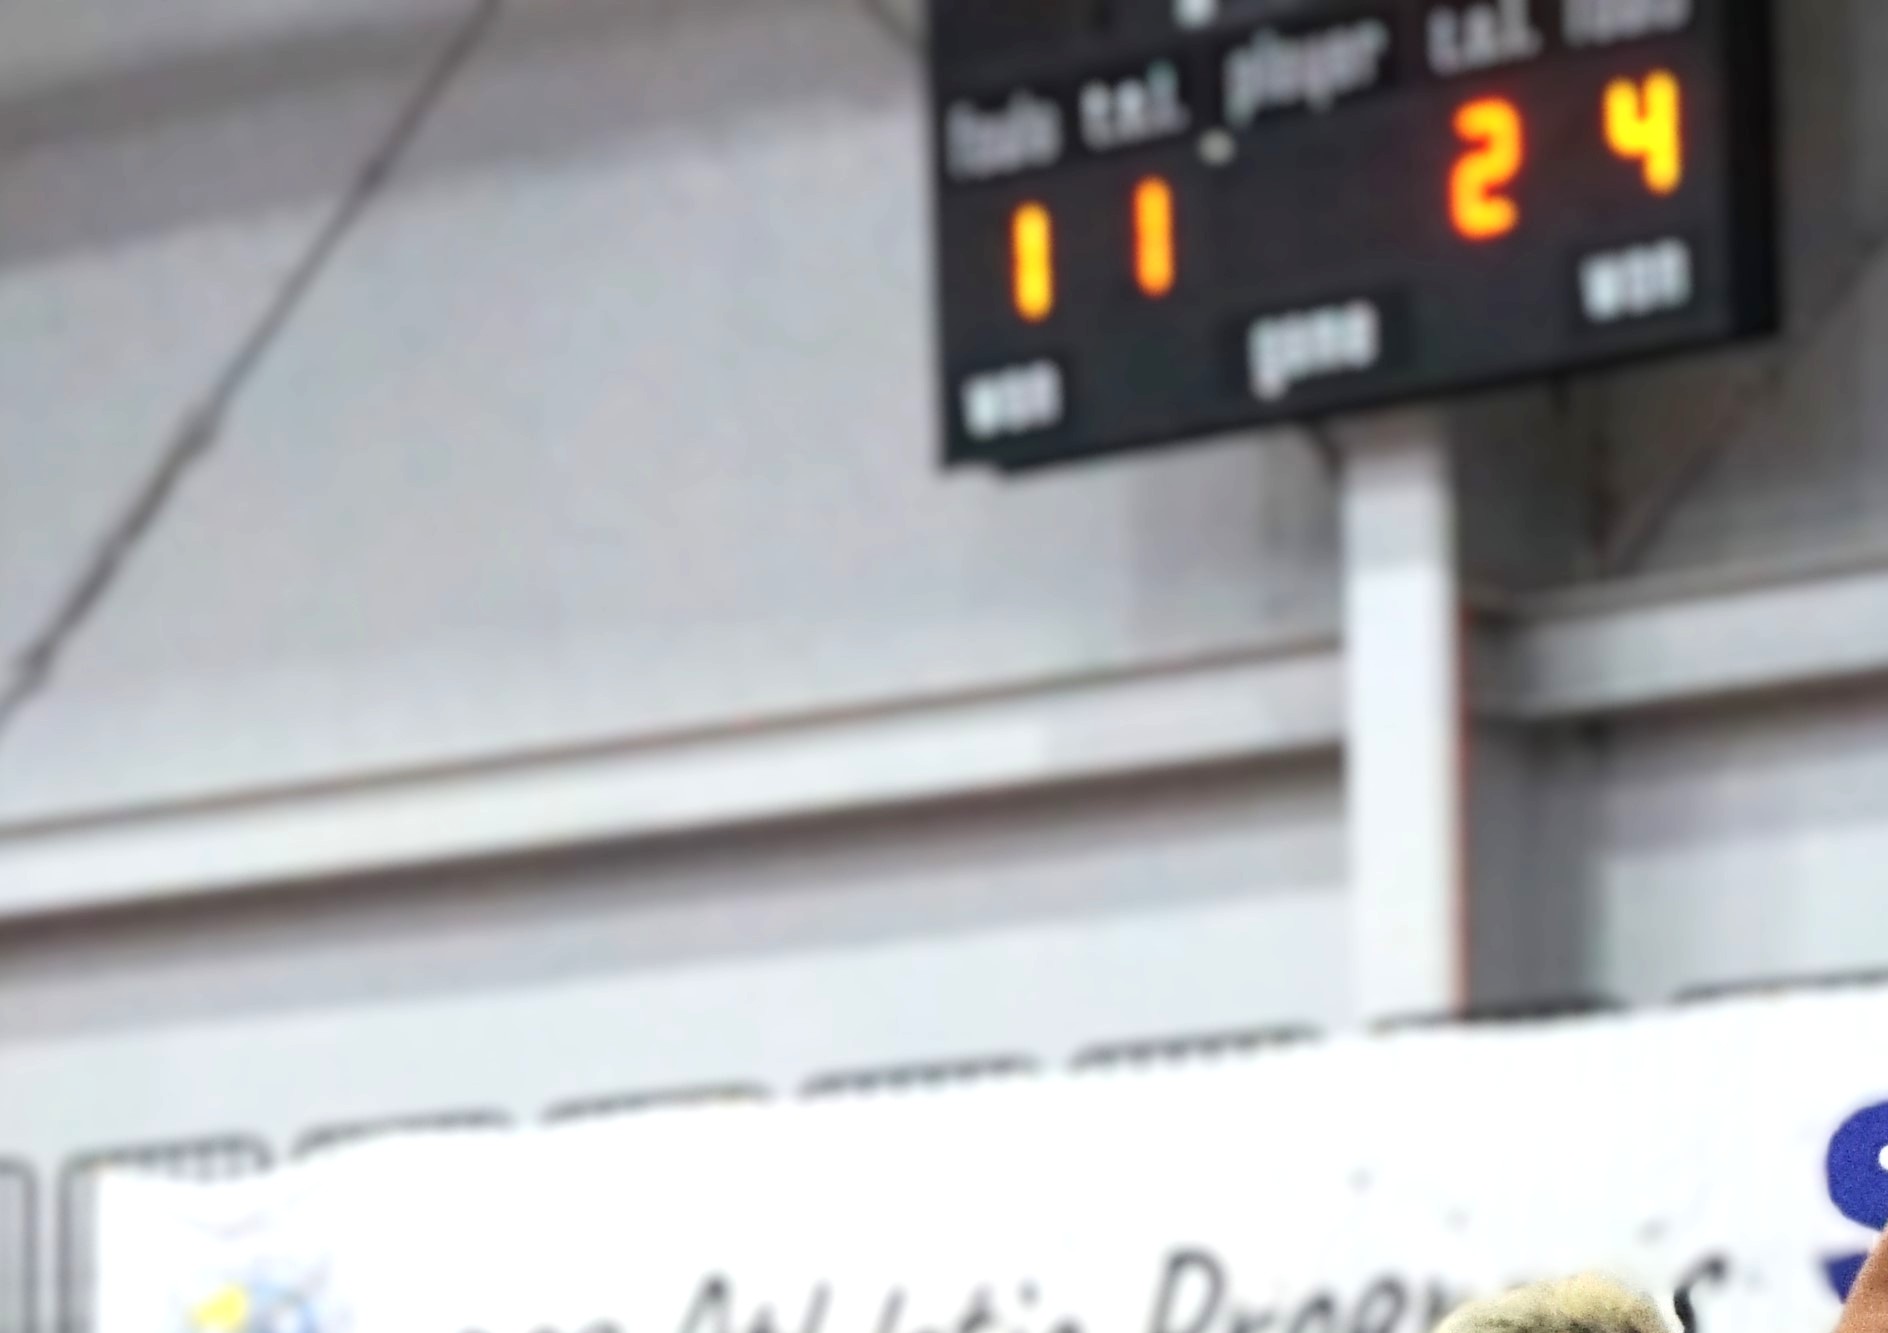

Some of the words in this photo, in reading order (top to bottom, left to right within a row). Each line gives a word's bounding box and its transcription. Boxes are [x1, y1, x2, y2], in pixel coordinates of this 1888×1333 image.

[1449, 96, 1524, 242] 2
[1602, 68, 1682, 196] 4
[1012, 202, 1054, 321] 1
[1132, 174, 1176, 298] 1
